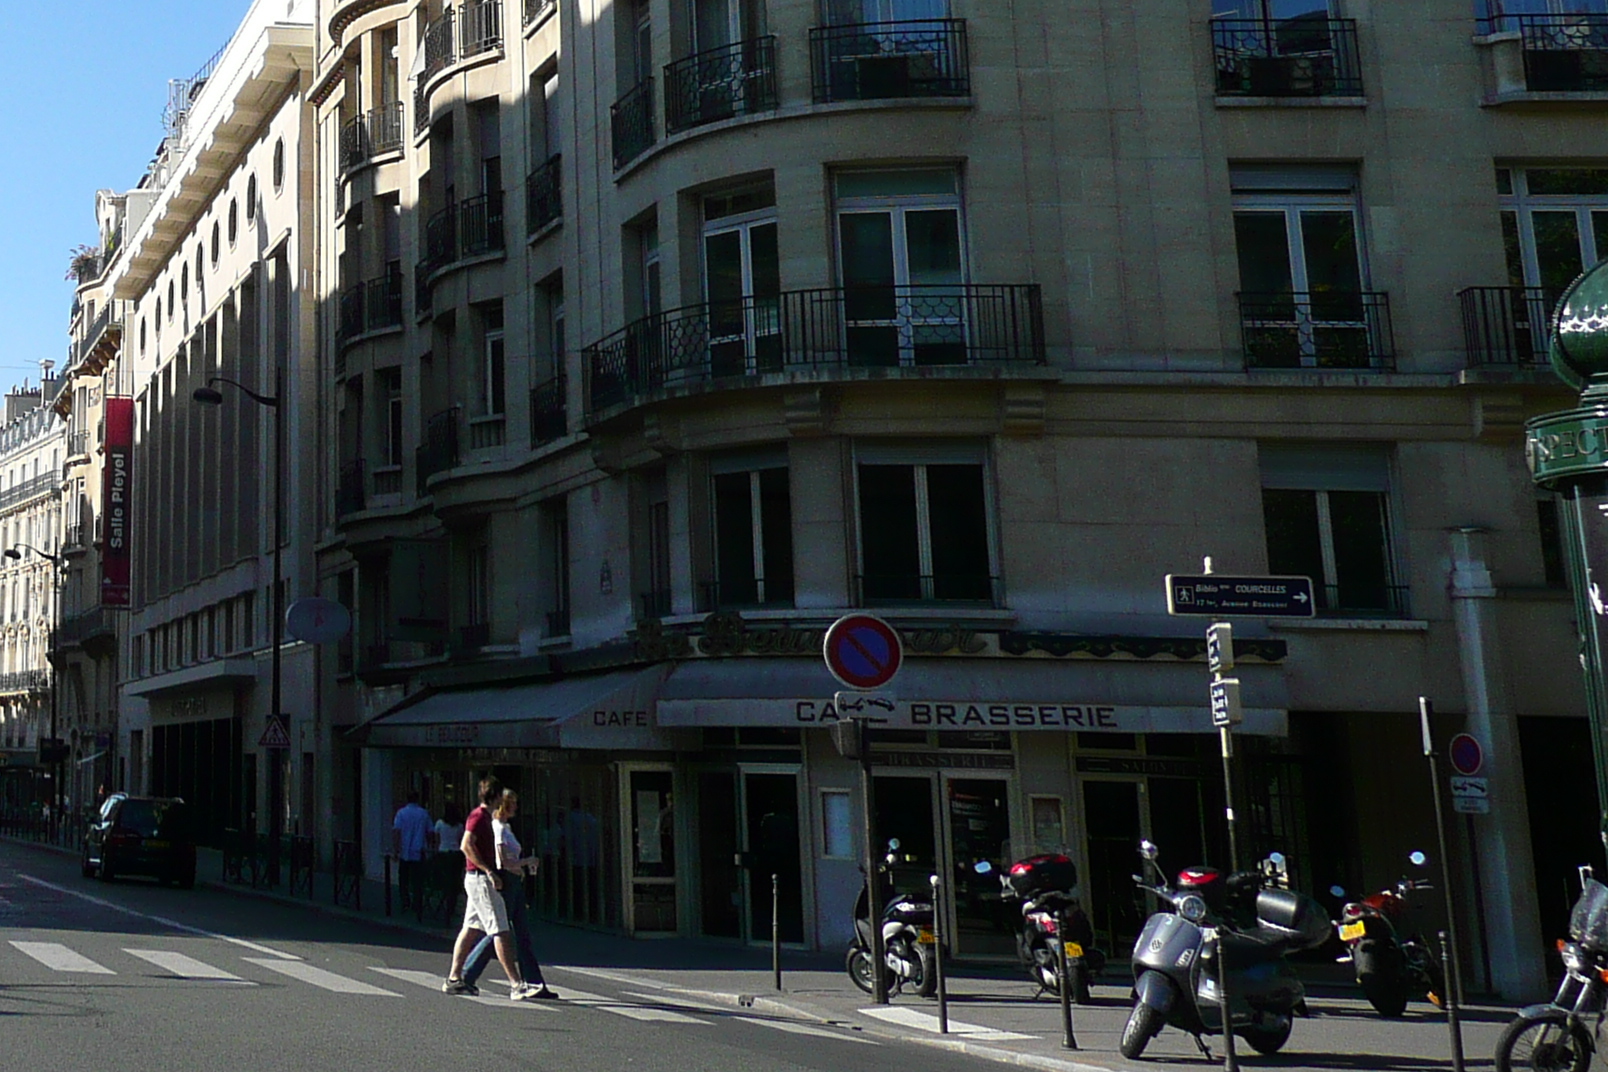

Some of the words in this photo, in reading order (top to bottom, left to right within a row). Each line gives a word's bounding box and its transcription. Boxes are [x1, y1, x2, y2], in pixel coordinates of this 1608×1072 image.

[111, 453, 127, 503] Pleyel
[110, 507, 124, 549] Salle
[1235, 584, 1287, 594] COURCELLES
[594, 711, 647, 726] CAFE
[910, 704, 1118, 727] BRASSERIE
